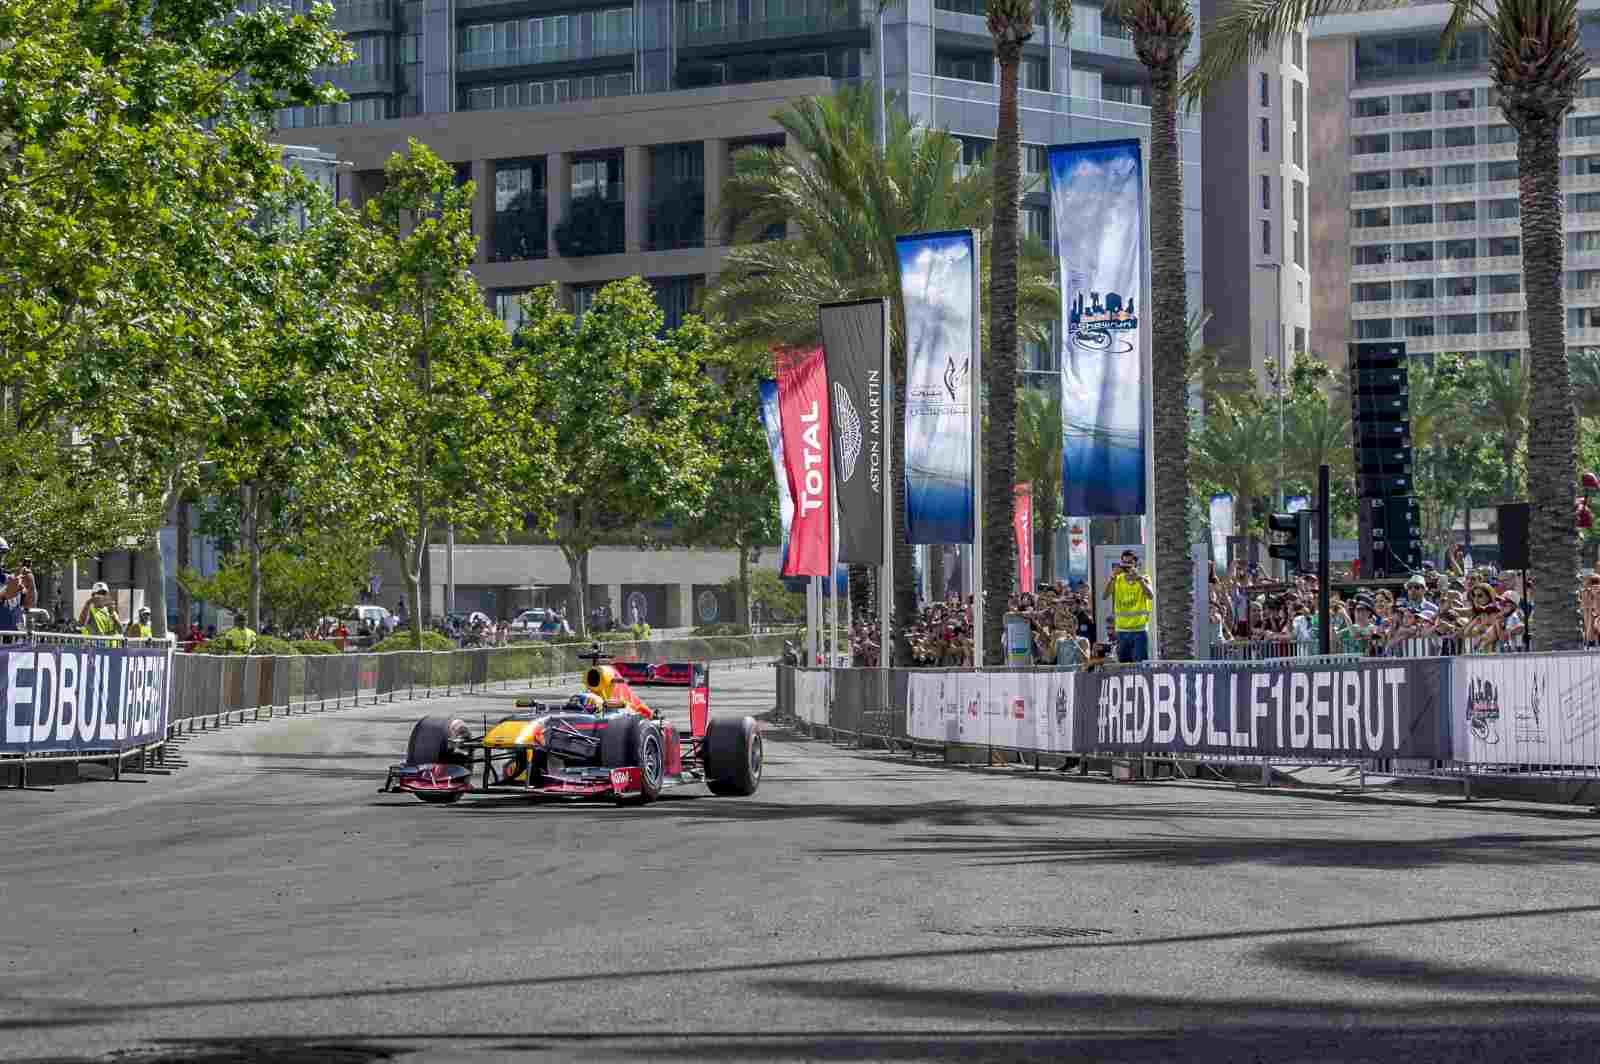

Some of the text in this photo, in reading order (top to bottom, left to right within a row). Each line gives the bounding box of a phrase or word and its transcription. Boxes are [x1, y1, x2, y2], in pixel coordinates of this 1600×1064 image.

[800, 400, 823, 518] TOTAL
[867, 370, 881, 493] ASTON MARTIN
[1097, 668, 1406, 751] #REDBULLF1BEIRUT
